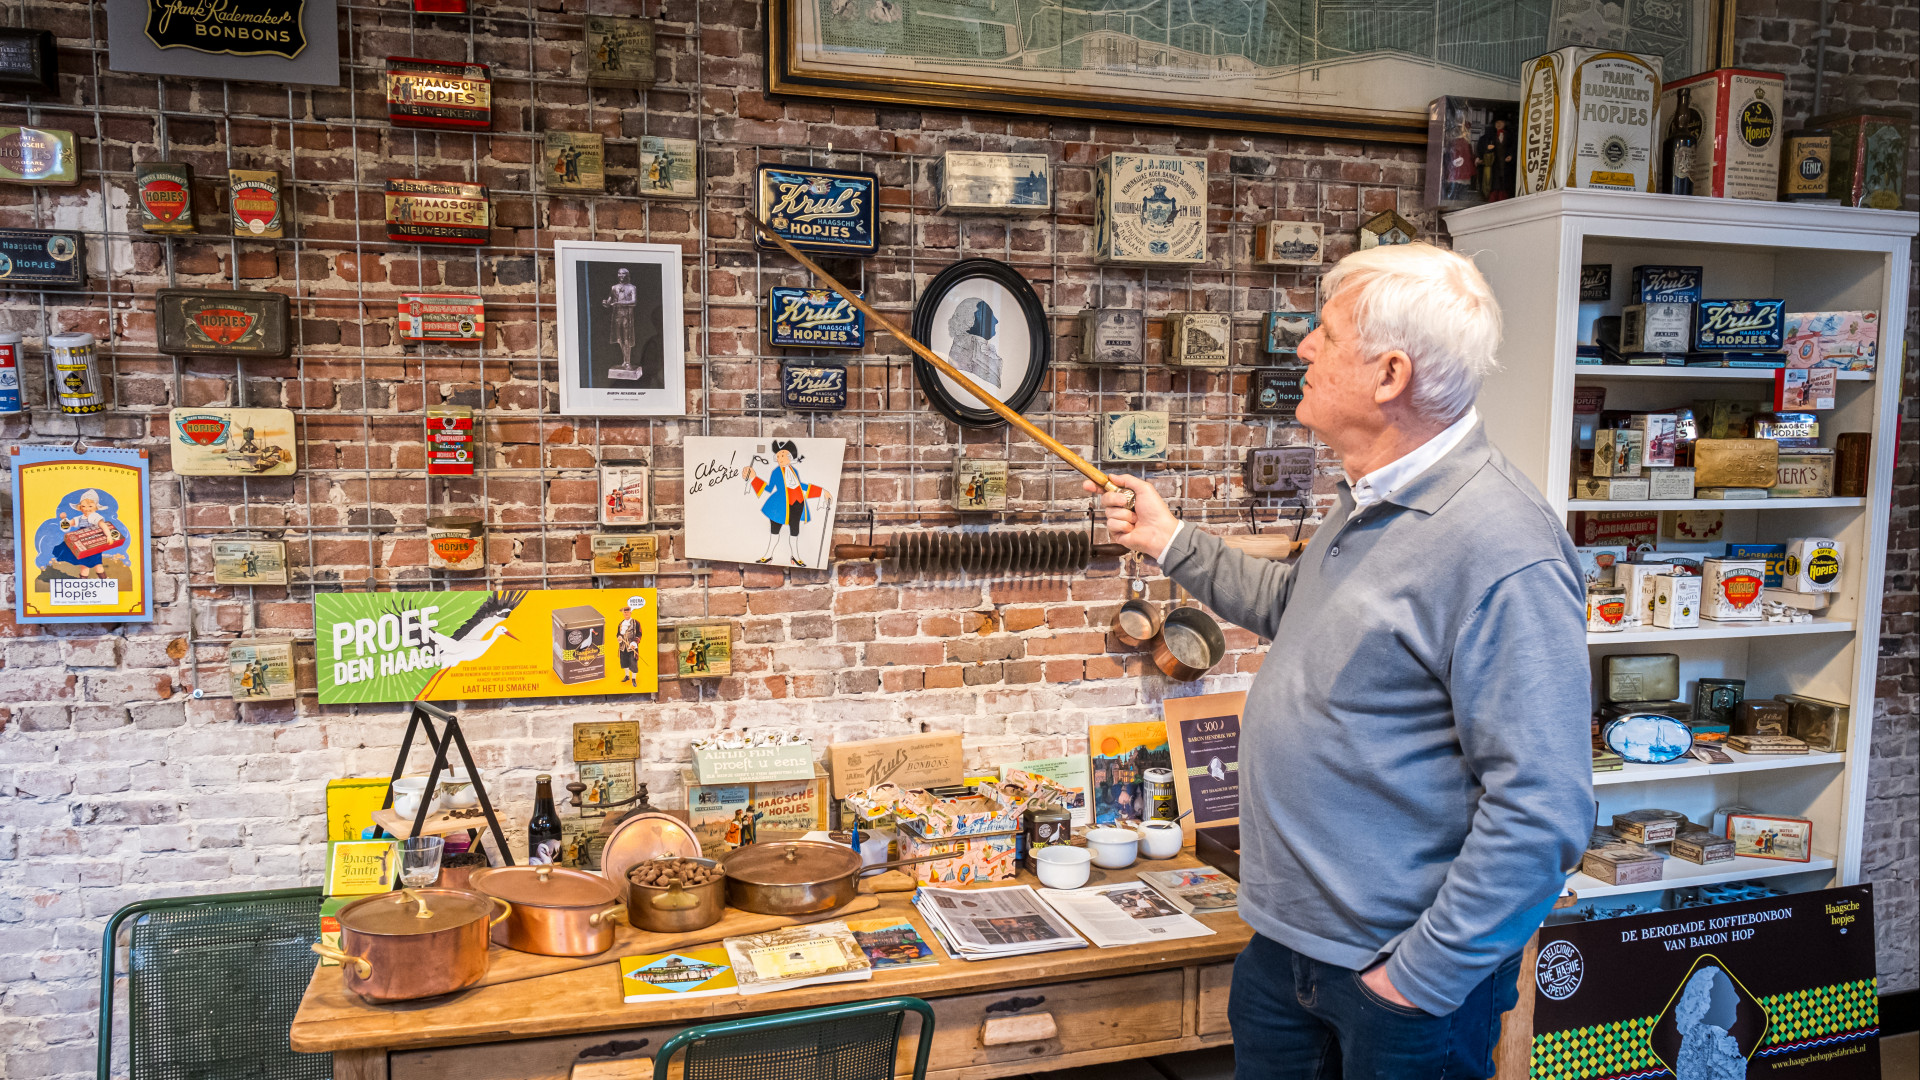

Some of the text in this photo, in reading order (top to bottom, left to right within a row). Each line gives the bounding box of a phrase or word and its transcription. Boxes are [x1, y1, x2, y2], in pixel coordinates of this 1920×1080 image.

[195, 24, 291, 43] BONBONS
[1602, 70, 1635, 86] FRANK
[1736, 76, 1743, 84] DE
[1542, 69, 1552, 107] FRANK
[1583, 83, 1649, 103] RADEMAKER'S
[413, 89, 476, 105] HOPJES
[400, 105, 480, 122] NIEUWERKERK
[1582, 103, 1648, 127] HOPJES
[1527, 92, 1544, 174] HOPJES
[1745, 126, 1771, 143] HOPJES
[1802, 159, 1822, 175] FENIX
[232, 181, 249, 193] FRANK
[145, 190, 184, 203] HOPJES
[771, 182, 863, 223] Krul's
[413, 209, 474, 224] HOPJES
[817, 218, 855, 228] HAAGSCHE
[399, 225, 479, 239] NIEUWERKERK
[790, 222, 850, 238] HOPJES
[2, 241, 43, 254] Haagsche
[16, 257, 57, 268] HOPJES
[1580, 271, 1607, 291] rul's
[1643, 272, 1697, 298] Krul's
[1655, 295, 1690, 303] HOPJES
[775, 295, 858, 329] Krul's
[200, 314, 248, 328] HOPJES
[1700, 305, 1778, 335] Krul's
[793, 329, 848, 342] HOPJES
[818, 324, 851, 332] HAAGSCHE
[1715, 335, 1769, 346] HOPJES
[786, 370, 844, 395] Krul's
[798, 395, 837, 404] HOPJES
[186, 424, 221, 434] HOPJES
[1771, 429, 1809, 438] HOPJES
[689, 468, 740, 495] de echte
[1612, 512, 1633, 520] EENIG
[438, 543, 470, 551] HOPJES
[1817, 549, 1832, 557] KOFFIE
[1725, 570, 1738, 581] FRANK
[1809, 565, 1838, 582] HOPJES
[54, 578, 116, 592] Haagsche
[1728, 582, 1756, 594] HOPJES
[54, 588, 98, 601] Hopjes
[332, 605, 440, 661] PROEF
[334, 643, 442, 686] DEN HAAG!
[462, 682, 540, 694] LAAT HET U SMAKEN!
[1204, 721, 1219, 732] 300
[704, 750, 747, 760] ALTIJD
[713, 757, 807, 774] proeft u eens
[866, 747, 908, 788] Krul's
[908, 759, 949, 771] BONBONS
[757, 788, 815, 809] HAAGSCHE
[768, 802, 810, 817] HOPJES
[343, 852, 380, 865] Haags
[1824, 900, 1861, 915] Haagsche
[1621, 907, 1793, 943] DE BEROEMDE KOFFIEBONBON
[1830, 913, 1855, 928] hopjes
[1663, 928, 1755, 952] VAN BARON HOP
[1542, 944, 1575, 962] DELICIOUS
[1539, 959, 1581, 984] THE HAGUE
[1546, 974, 1579, 997] SPECIALTY
[1770, 1043, 1867, 1071] www.haagschehopjesfabriek.nl
